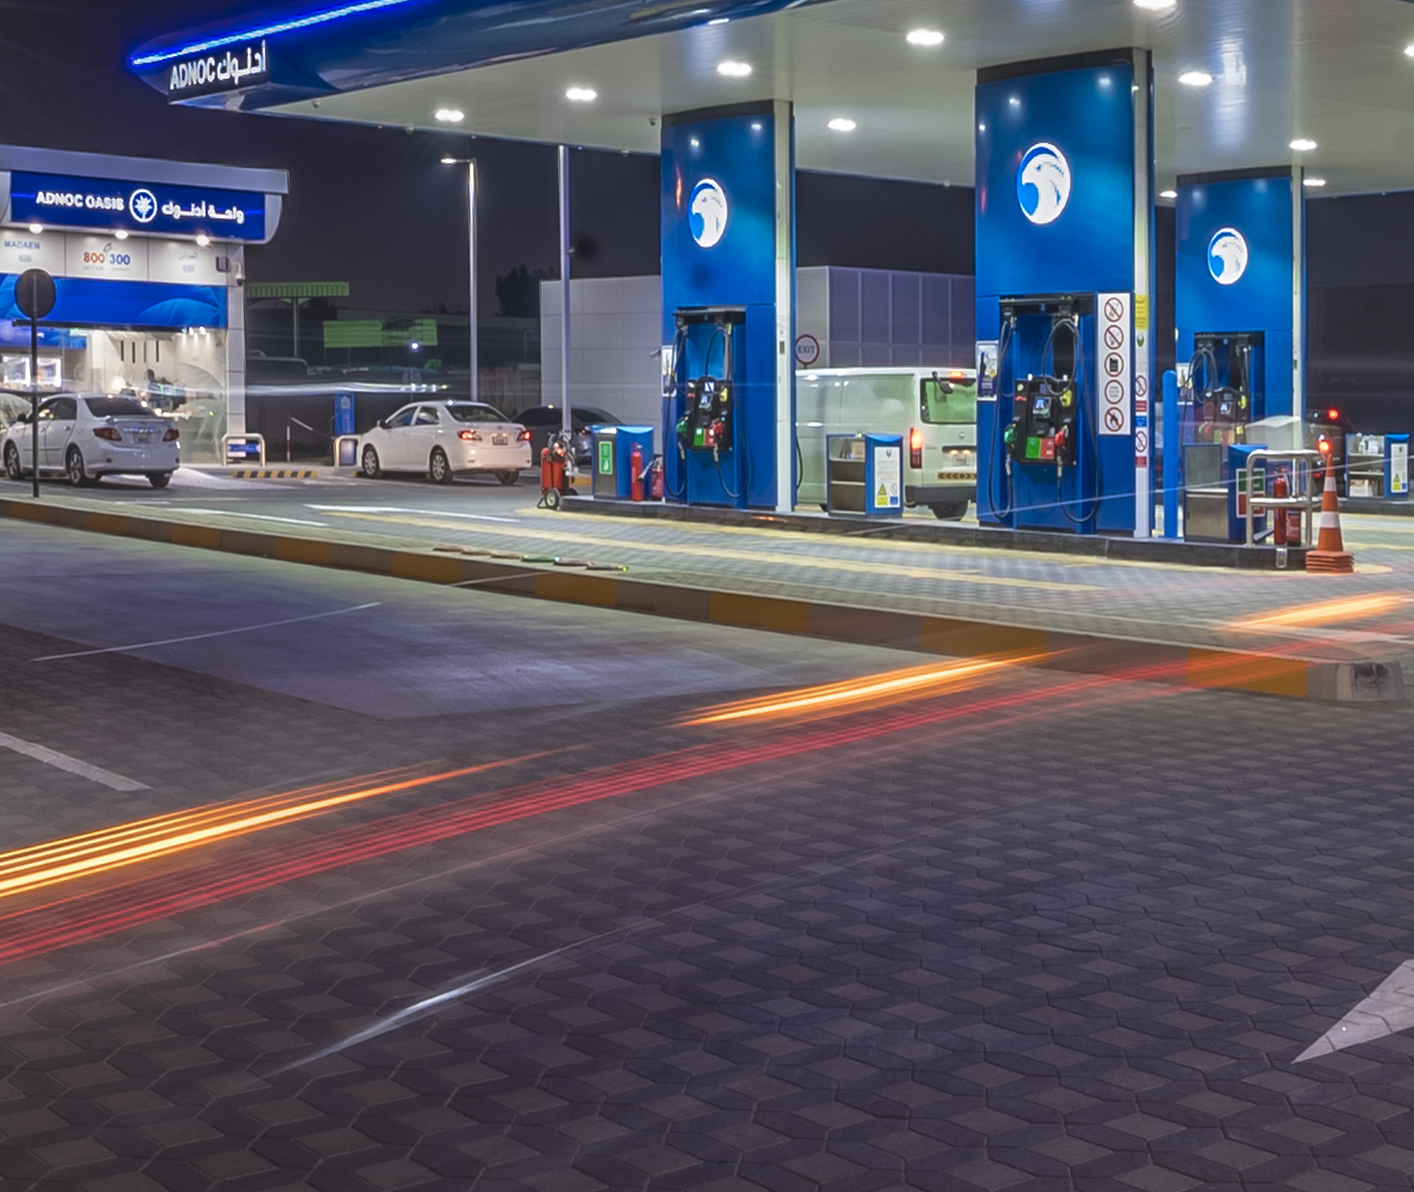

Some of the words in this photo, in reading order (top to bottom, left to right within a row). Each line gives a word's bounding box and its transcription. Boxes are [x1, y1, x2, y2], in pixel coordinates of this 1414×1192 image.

[216, 39, 266, 85] أدنوك
[170, 57, 215, 90] ADNOC
[36, 191, 83, 207] ADNOC
[85, 194, 125, 211] OASIS
[4, 240, 40, 250] MADAEN
[83, 251, 105, 264] 800
[109, 253, 131, 266] 300
[798, 345, 815, 354] EXIT
